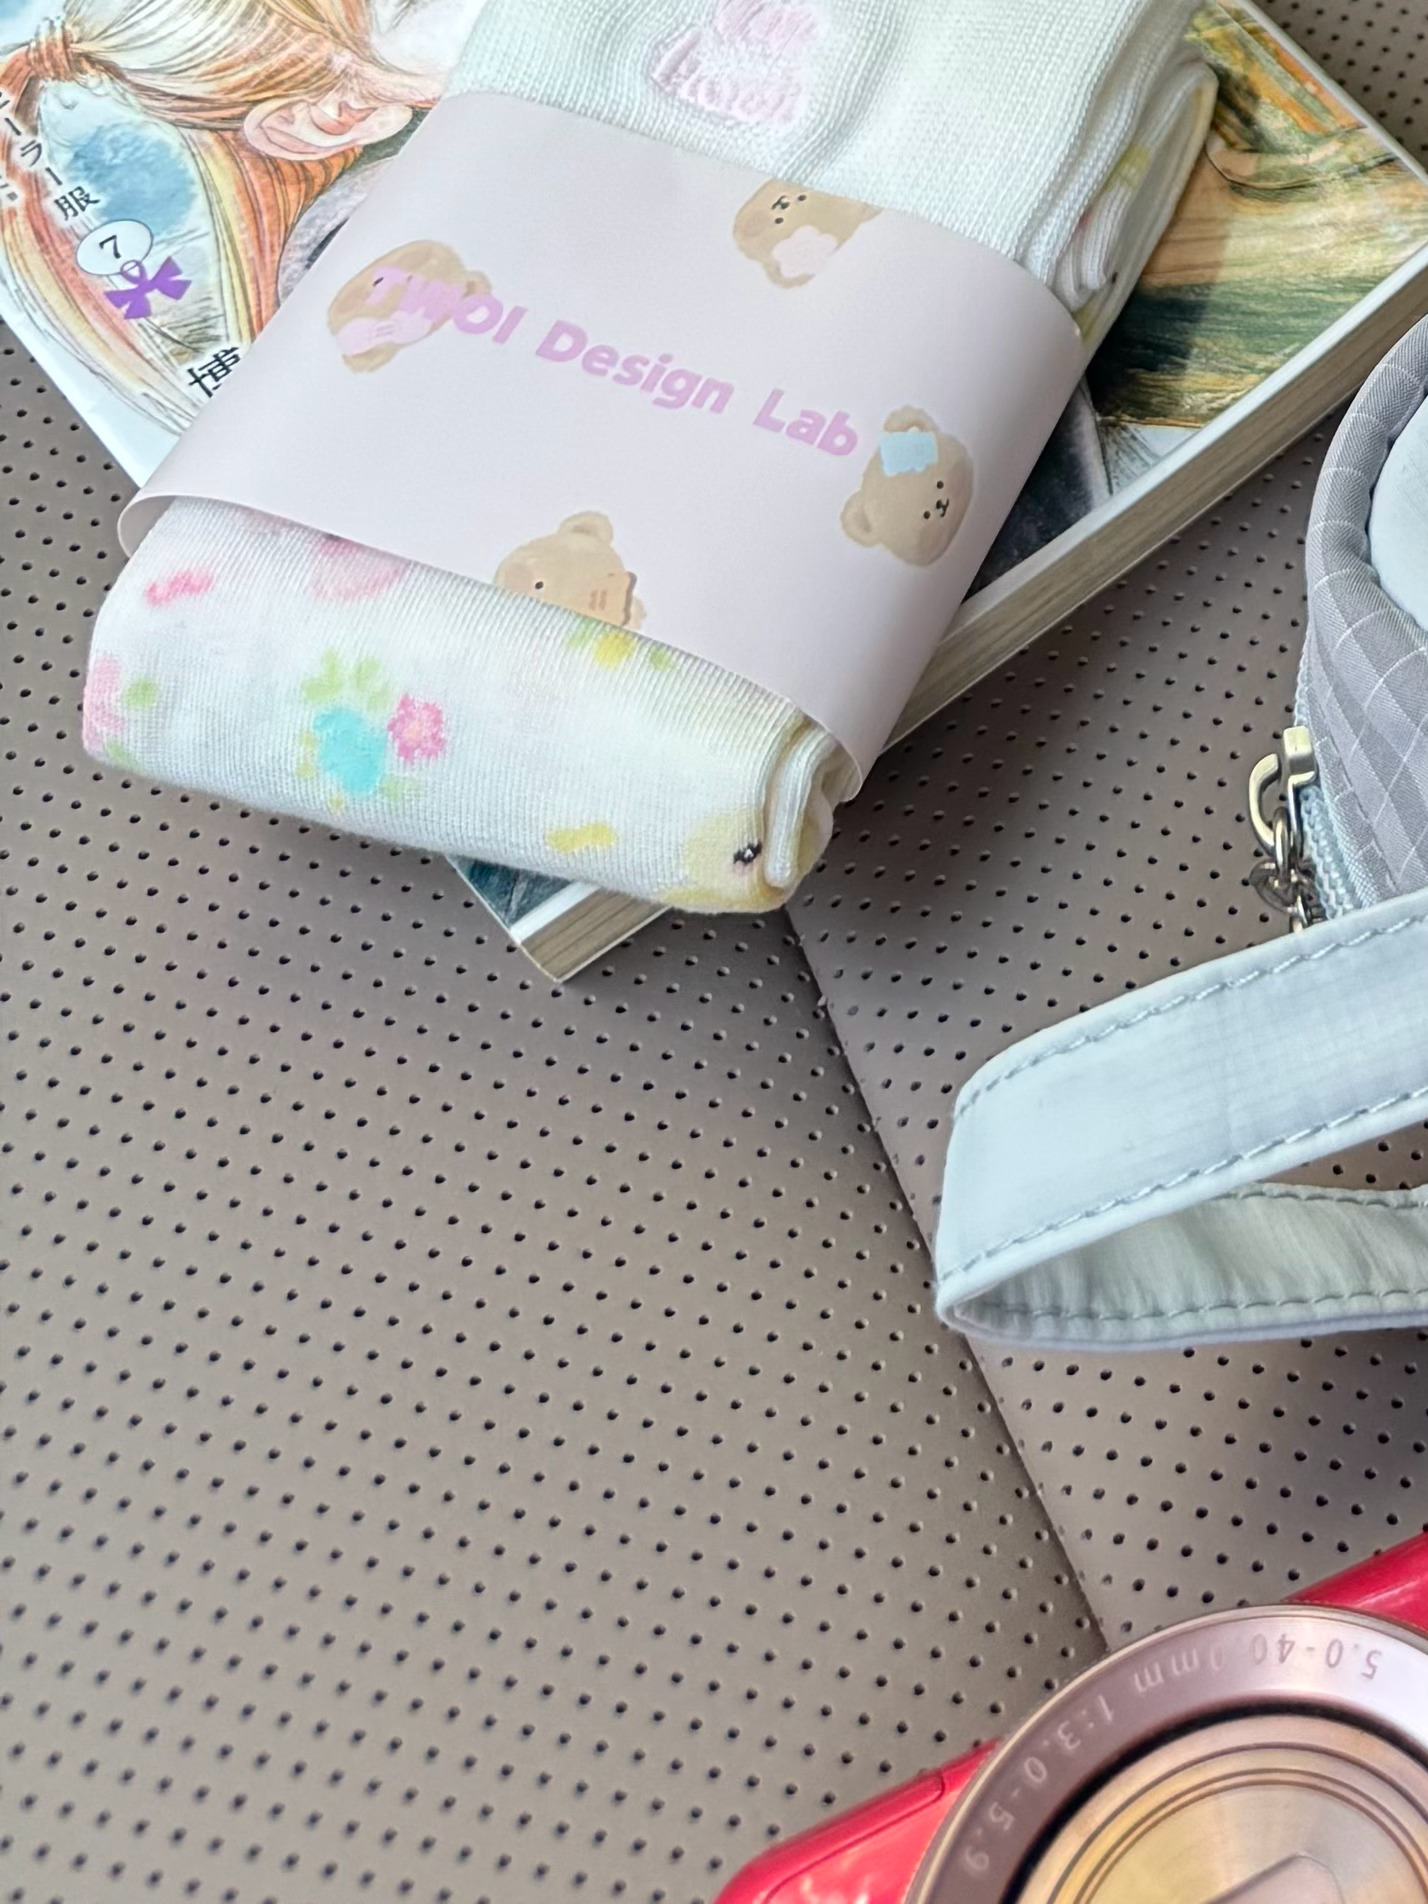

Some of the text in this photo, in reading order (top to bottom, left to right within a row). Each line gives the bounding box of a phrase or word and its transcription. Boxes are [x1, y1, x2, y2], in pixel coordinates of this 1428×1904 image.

[0, 92, 101, 221] ーラー服
[98, 234, 122, 259] 7
[534, 319, 737, 415] Design
[753, 389, 859, 458] Lab
